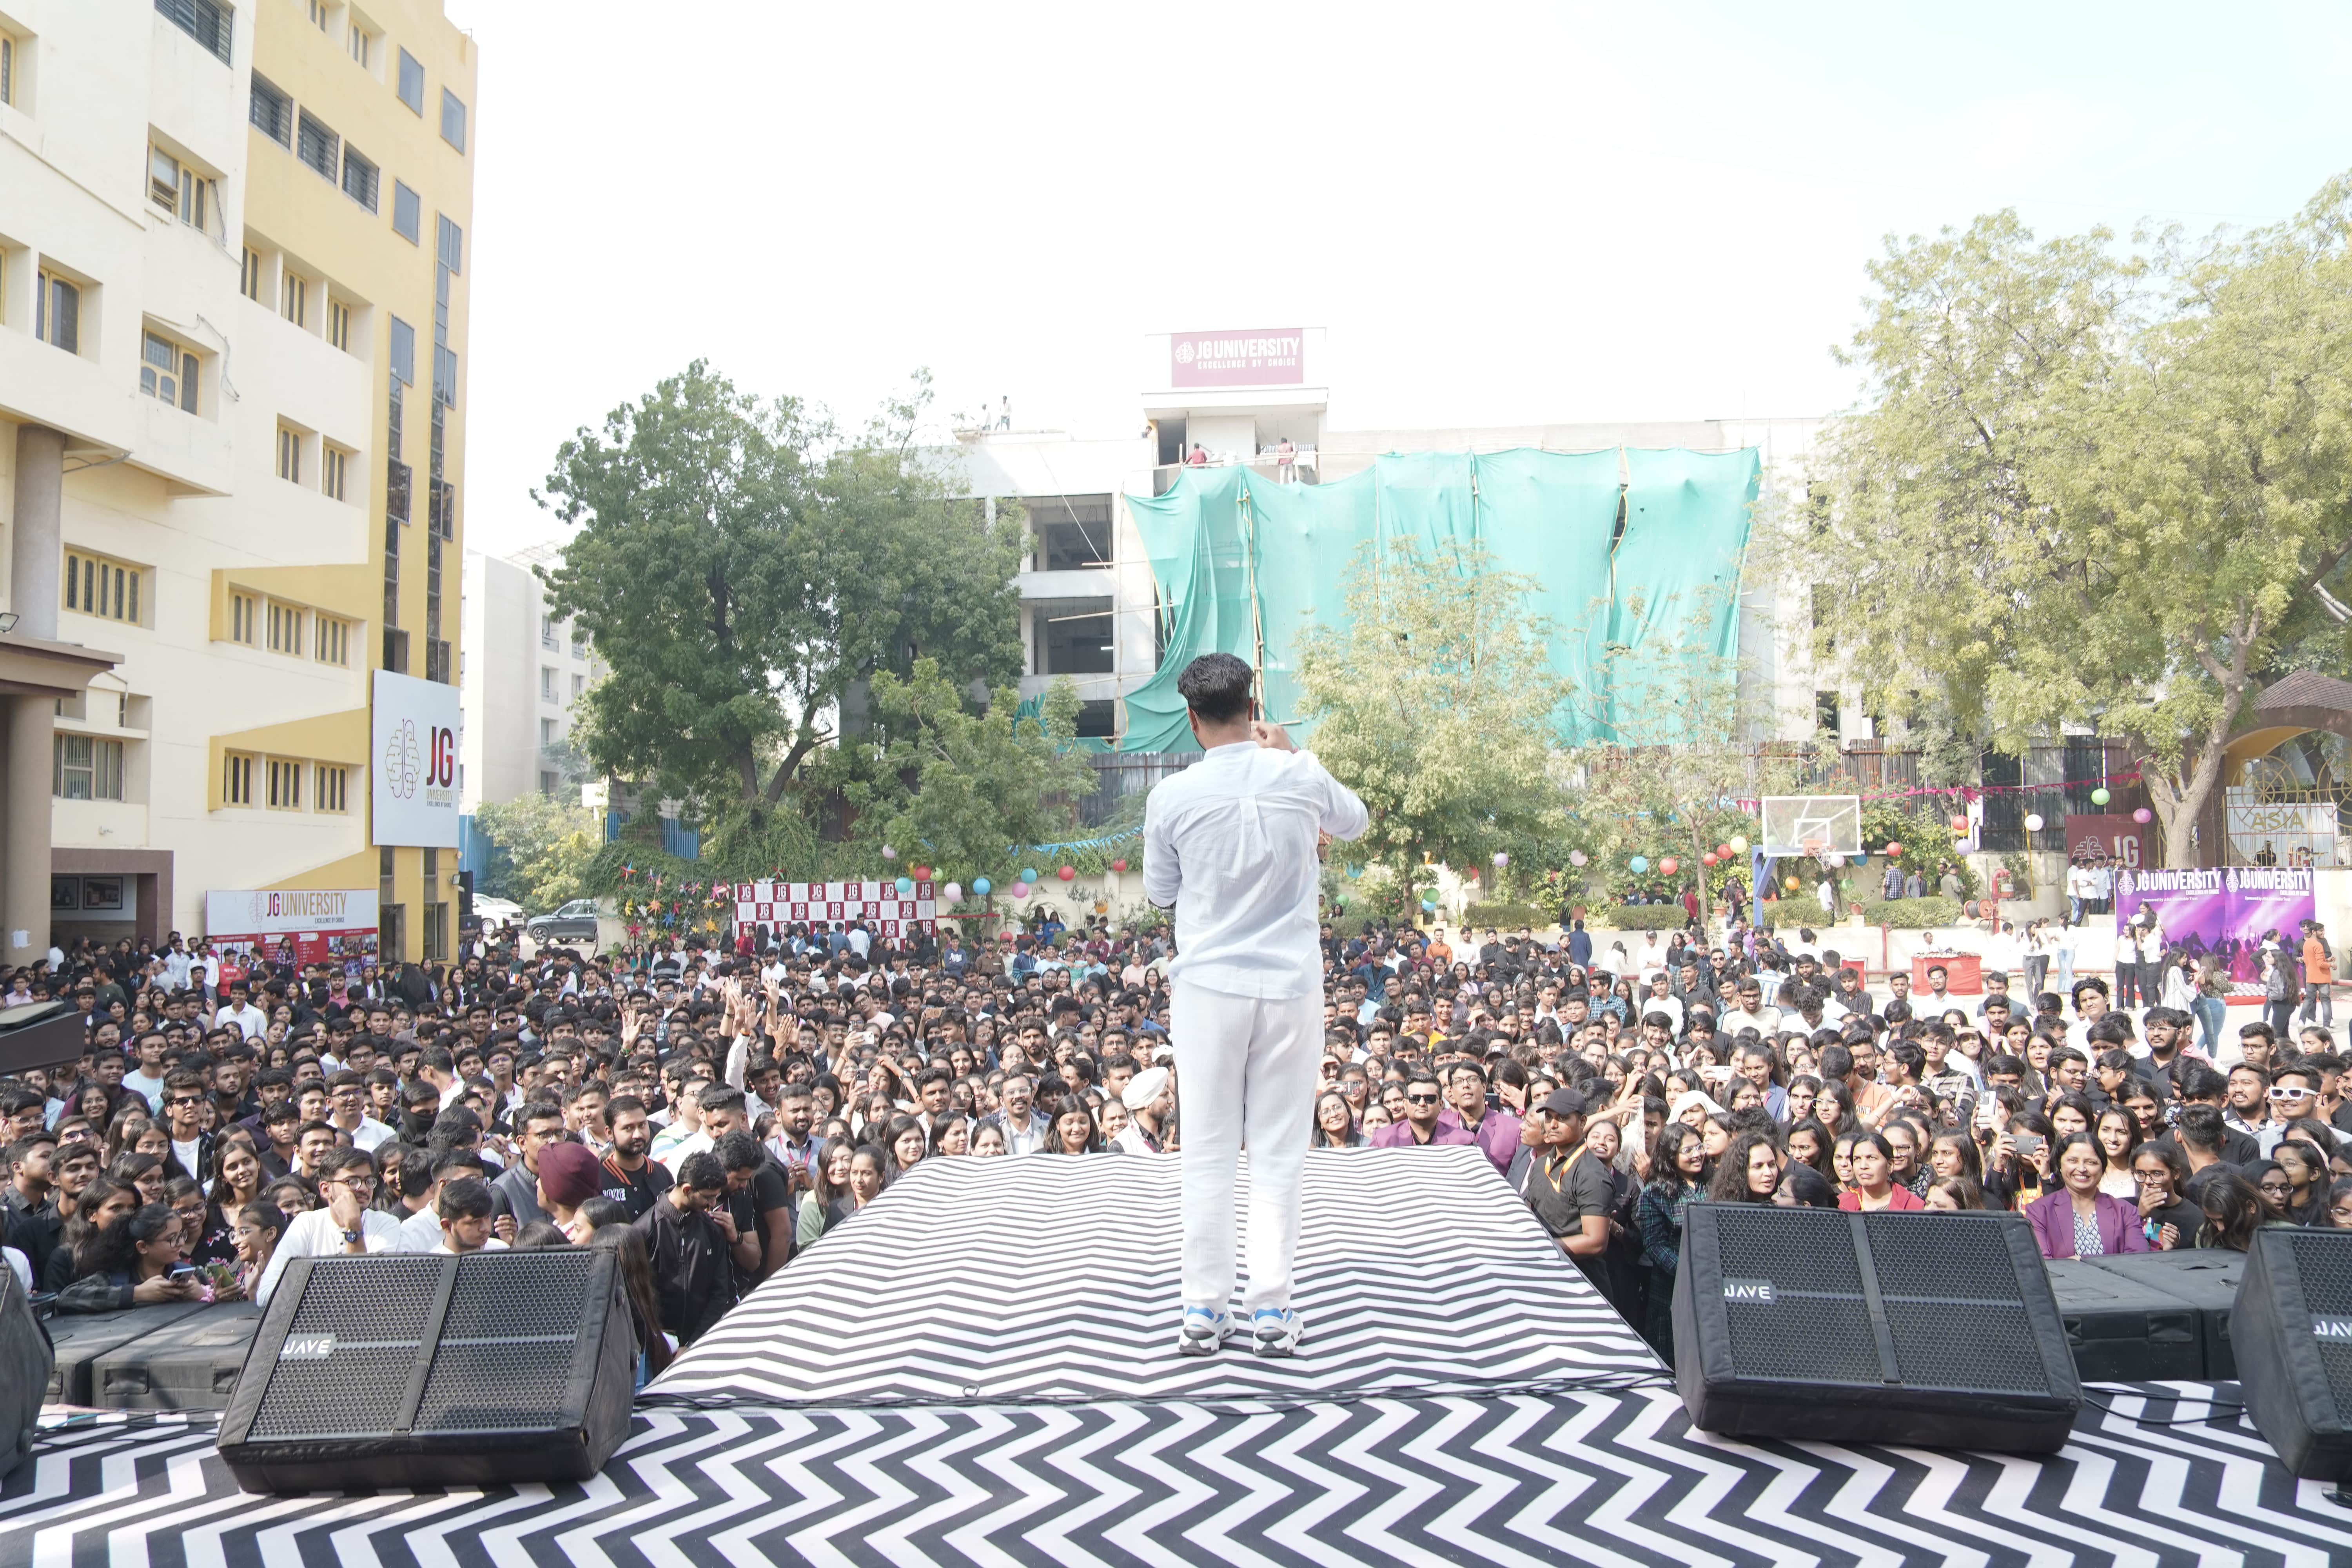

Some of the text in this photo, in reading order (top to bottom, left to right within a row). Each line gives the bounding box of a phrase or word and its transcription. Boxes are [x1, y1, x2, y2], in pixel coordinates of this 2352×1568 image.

[1196, 337, 1300, 359] JG UNIVERSITY
[1198, 358, 1296, 370] EXCELLENCE BY CHOICE
[426, 726, 453, 788] JG
[426, 788, 453, 801] UNIVERSITY
[2251, 812, 2305, 829] ASIA
[2114, 835, 2138, 867] JG
[2136, 871, 2221, 891] JG UNIVERSITY
[2239, 871, 2311, 890] JG UNIVERSITY
[741, 886, 751, 898] JG
[777, 885, 786, 897] JG
[812, 885, 822, 897] JG
[848, 884, 858, 897] JG
[884, 884, 894, 896] JG
[920, 883, 930, 896] JG
[267, 892, 347, 917] JG UNIVERSITY
[759, 904, 769, 916] JG
[795, 903, 805, 915] JG
[831, 903, 840, 915] JG
[866, 902, 876, 915] JG
[902, 902, 912, 915] JG
[885, 920, 895, 933] JG
